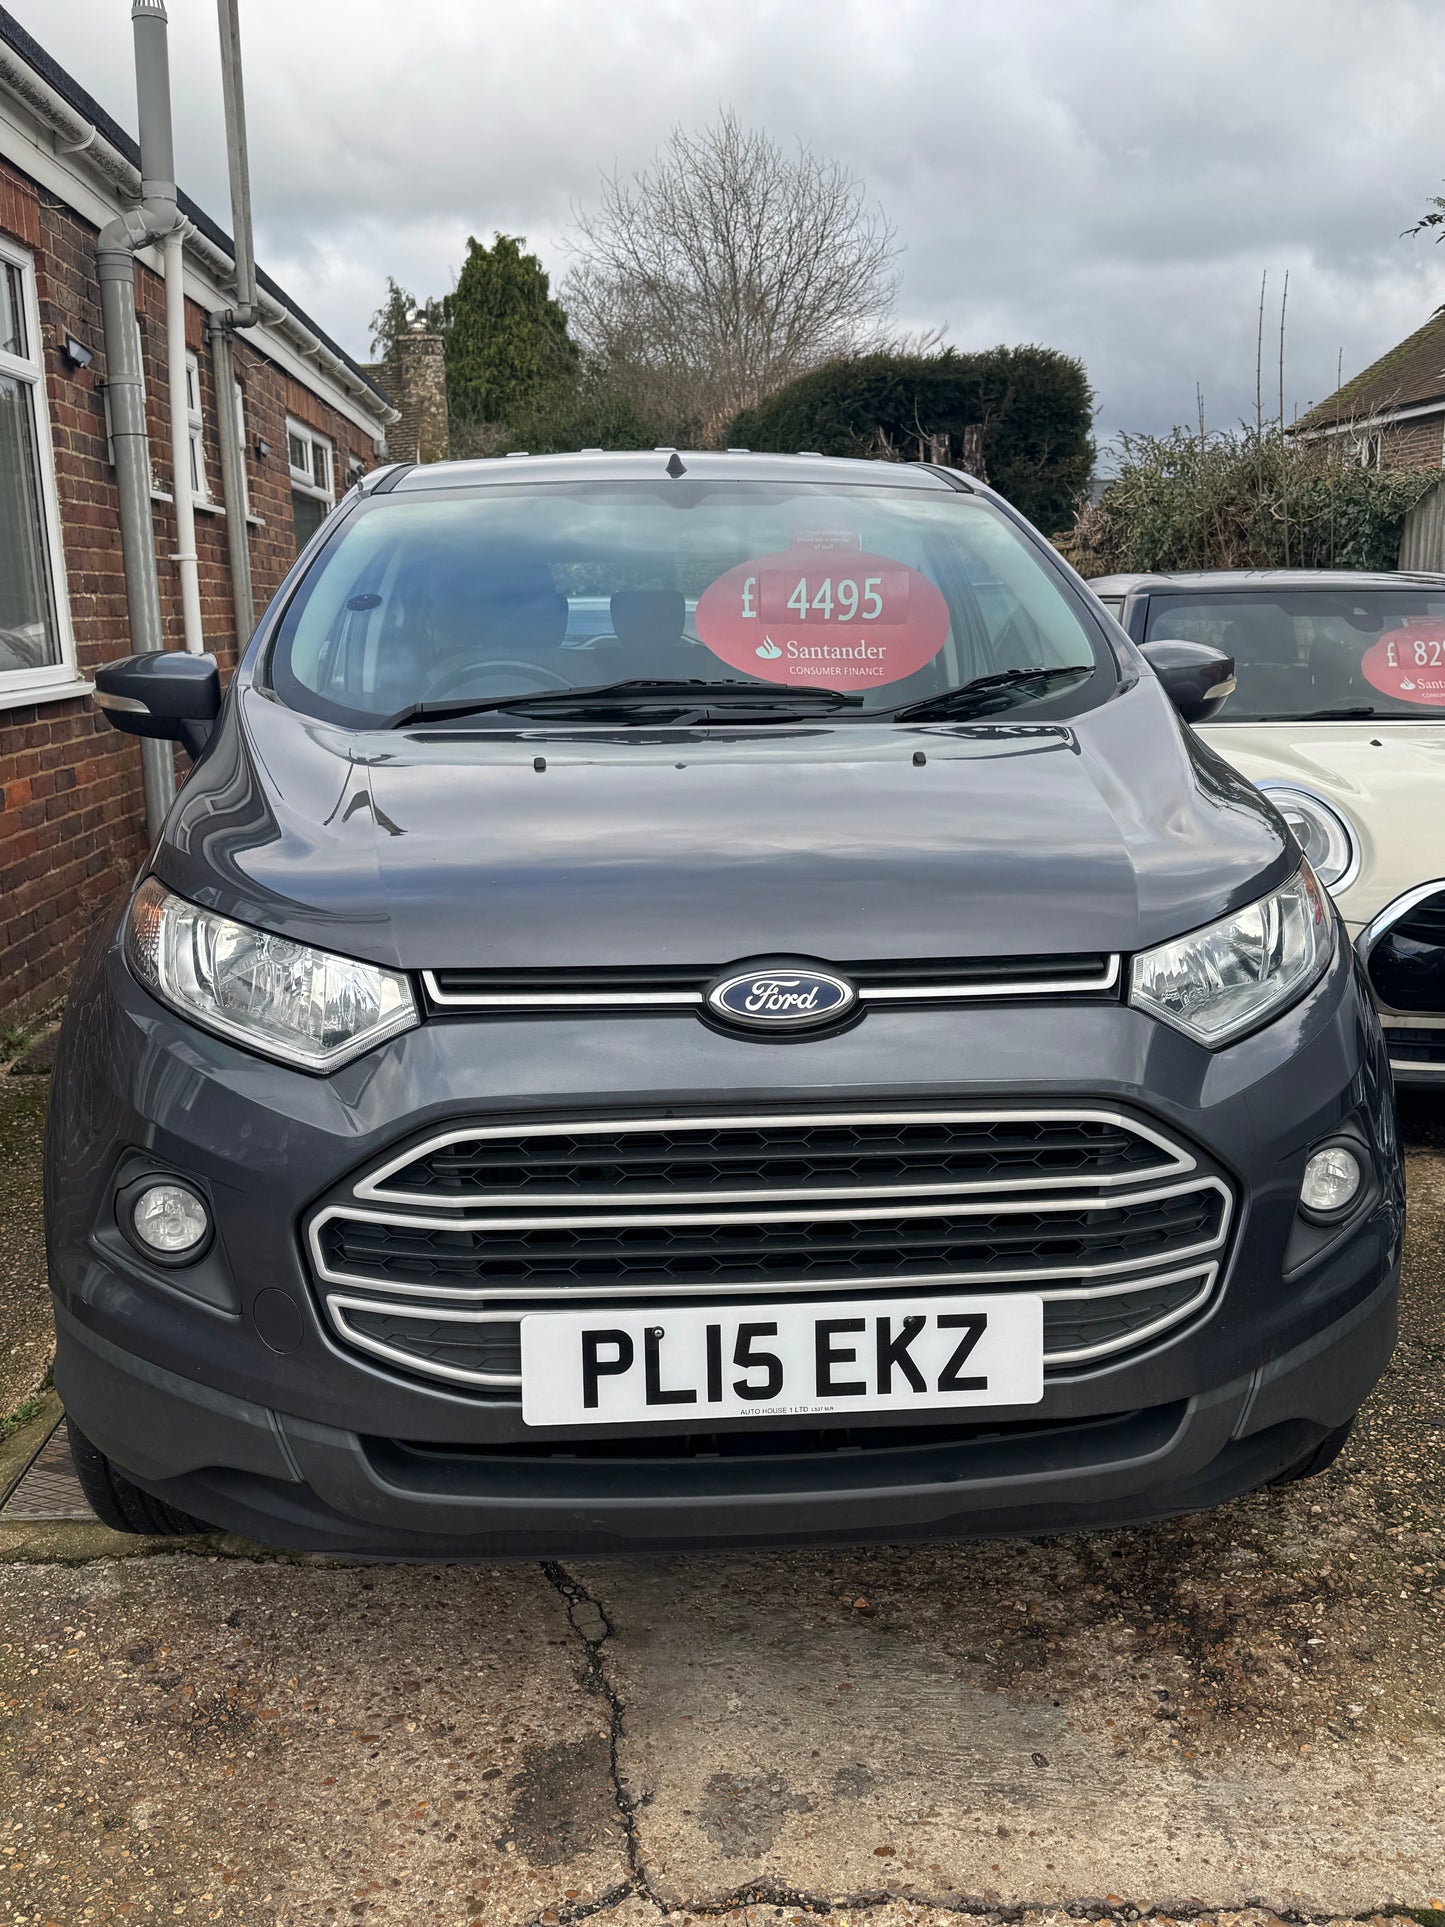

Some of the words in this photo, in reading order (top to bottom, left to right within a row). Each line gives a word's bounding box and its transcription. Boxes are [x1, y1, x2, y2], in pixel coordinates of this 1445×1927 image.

[742, 577, 757, 618] £
[787, 577, 883, 621] 4495
[786, 639, 886, 660] Santander
[1387, 642, 1398, 667] £
[789, 666, 842, 676] CONSUMER
[844, 667, 885, 676] FINANCE
[1417, 678, 1445, 690] Sant
[745, 980, 819, 1011] Ford
[581, 1321, 784, 1408] PL15
[815, 1312, 988, 1397] EKZ
[762, 1406, 787, 1414] HOUSE
